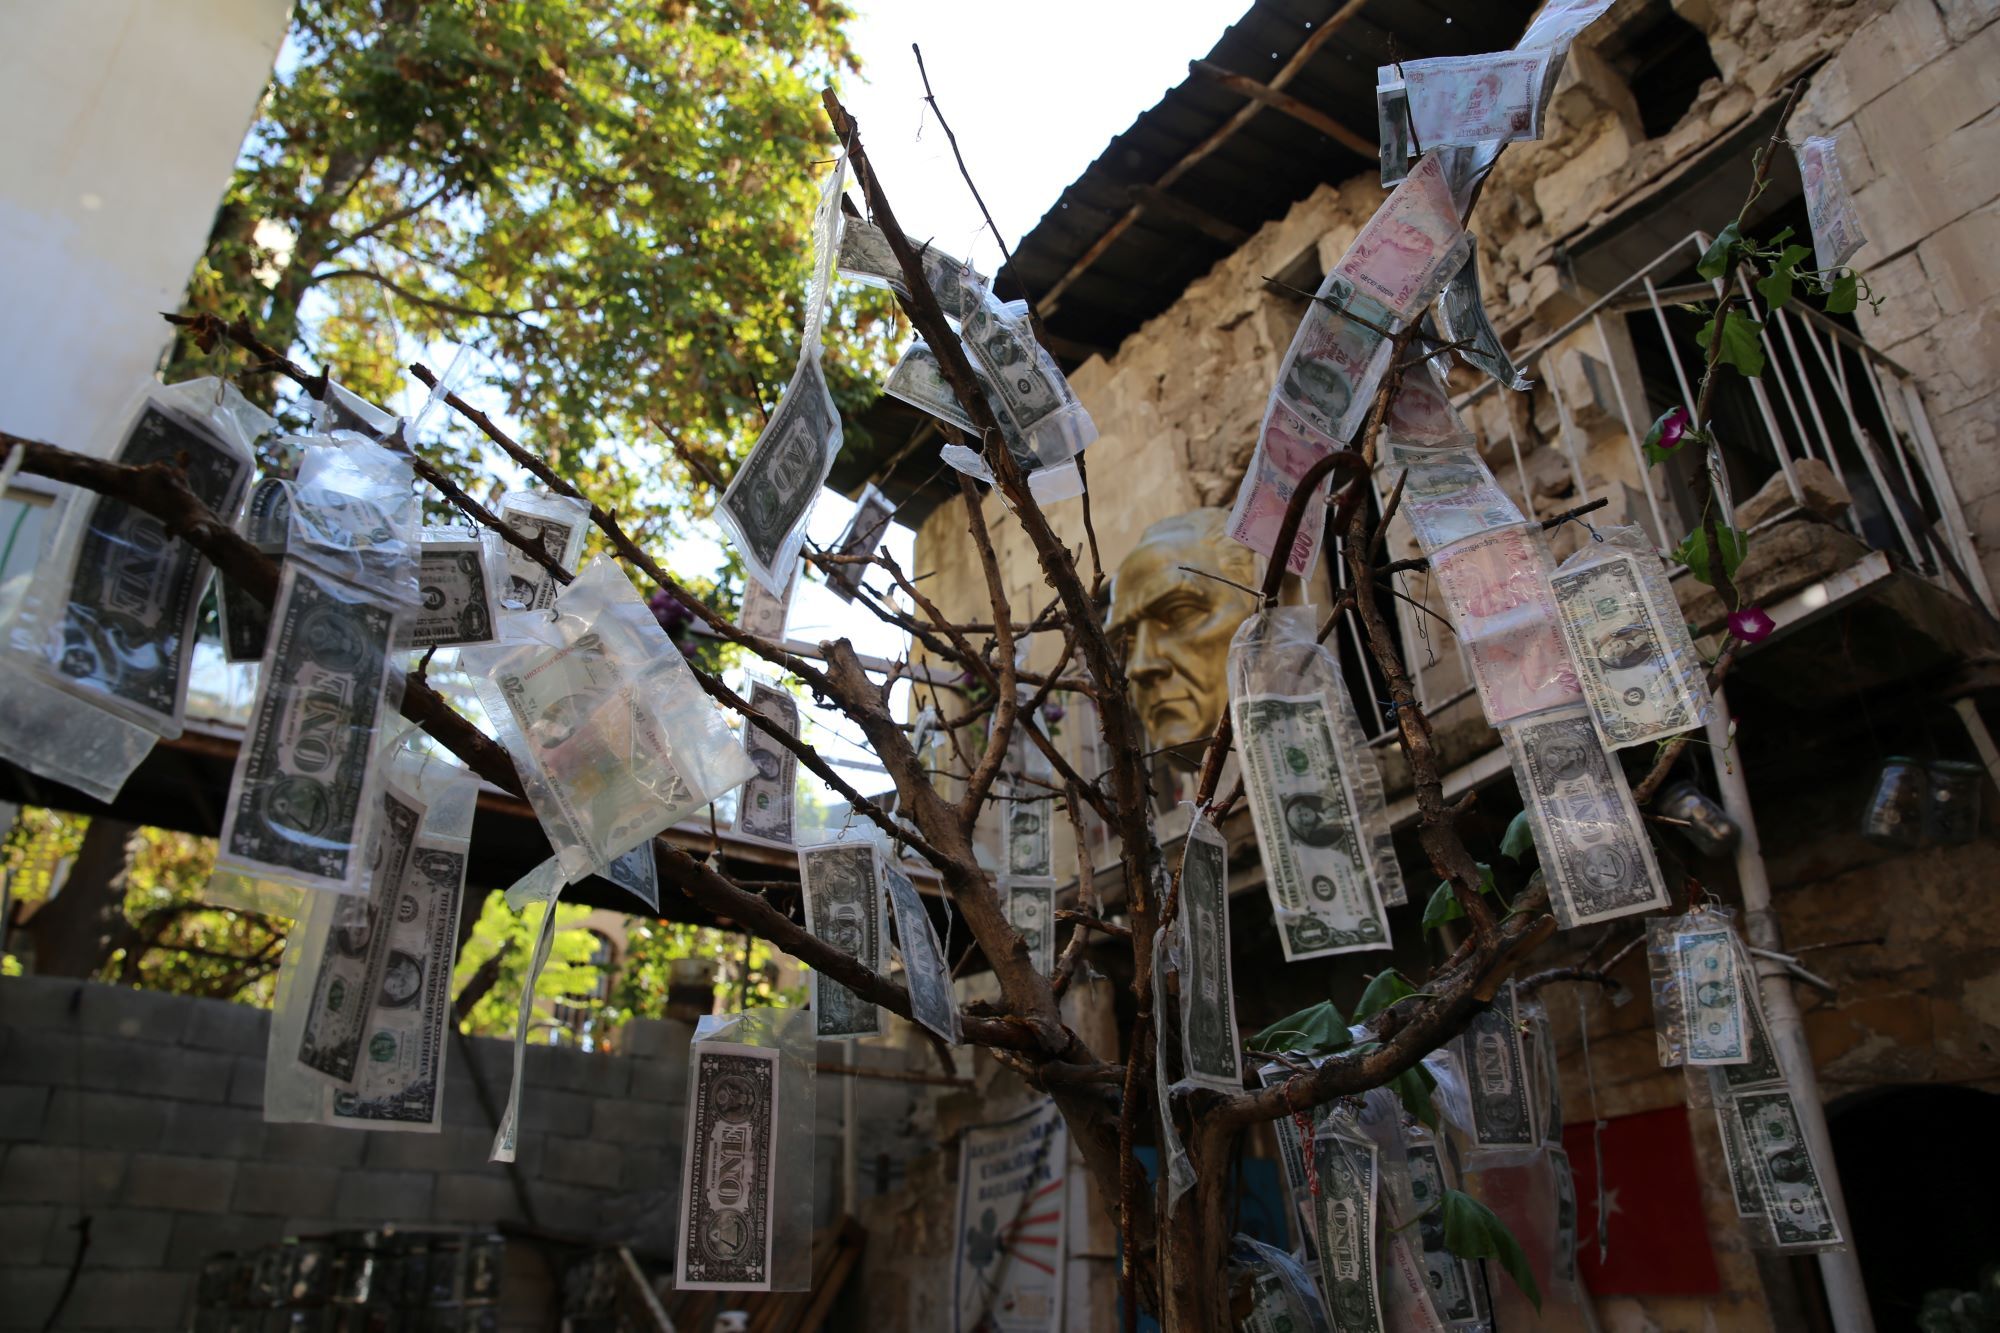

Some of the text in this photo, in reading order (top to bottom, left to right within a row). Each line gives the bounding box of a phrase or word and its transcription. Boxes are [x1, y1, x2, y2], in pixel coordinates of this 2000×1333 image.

[773, 426, 815, 494] ONE
[109, 515, 168, 620] ONE
[1286, 527, 1314, 575] 200
[293, 665, 348, 774] ONE
[1331, 771, 1353, 830] DOLLAR
[1563, 778, 1607, 844] ONE
[430, 917, 446, 961] UNITED
[1198, 910, 1216, 1000] ONE
[424, 962, 440, 1006] STATES
[415, 1024, 434, 1079] AMERICA
[1481, 1035, 1504, 1093] ONE
[696, 1081, 706, 1128] AMERICA
[692, 1142, 702, 1184] STATES
[716, 1125, 746, 1206] ONE
[690, 1185, 699, 1224] UNITED
[688, 1224, 697, 1248] THE
[1330, 1200, 1352, 1279] ONE
